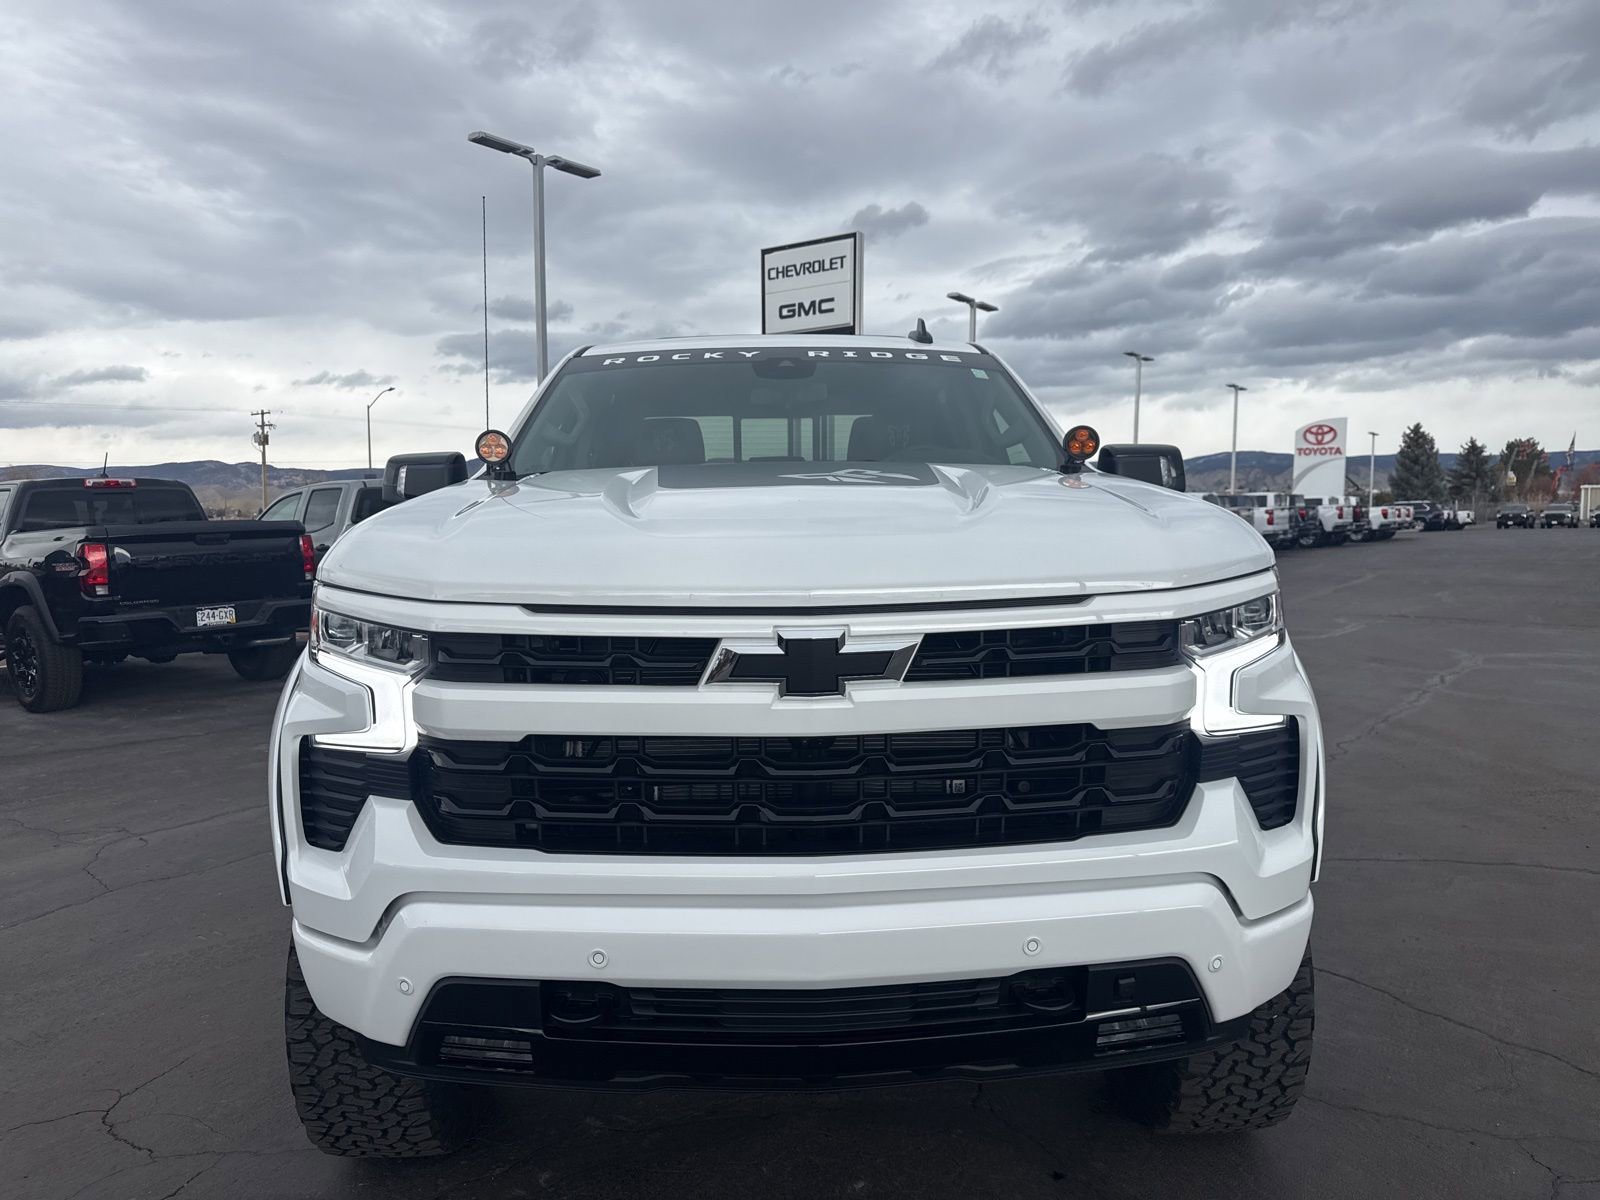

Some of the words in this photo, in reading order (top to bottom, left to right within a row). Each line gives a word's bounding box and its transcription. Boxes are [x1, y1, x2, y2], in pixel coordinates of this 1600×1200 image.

[767, 255, 847, 280] CHEVROLET
[778, 297, 835, 320] GMC
[602, 351, 761, 365] ROCKY
[807, 350, 962, 362] RIDGE
[1296, 446, 1342, 456] TOYOTA
